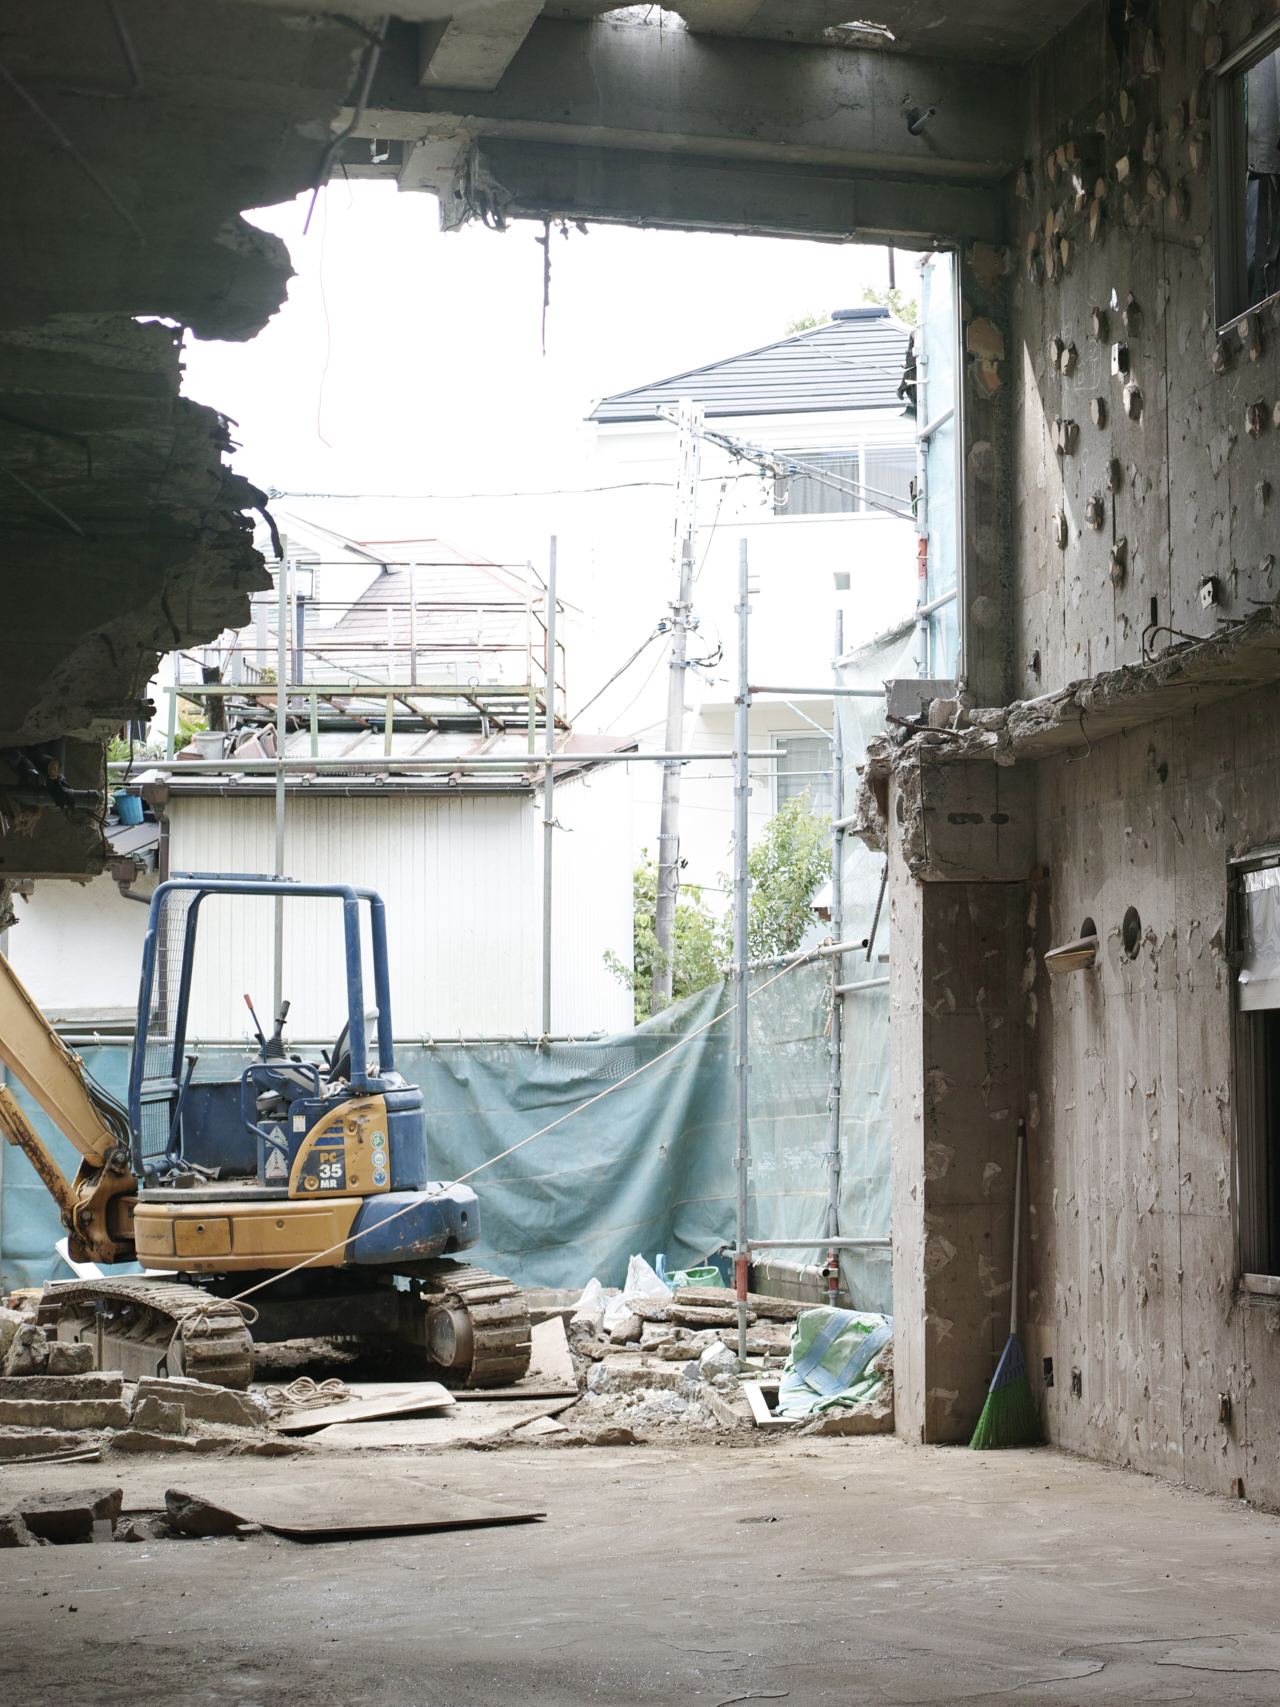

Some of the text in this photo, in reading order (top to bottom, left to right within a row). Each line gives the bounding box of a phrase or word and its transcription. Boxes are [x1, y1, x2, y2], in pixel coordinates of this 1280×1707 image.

[319, 1152, 338, 1164] PC
[319, 1163, 342, 1178] 35
[320, 1179, 338, 1189] MR
